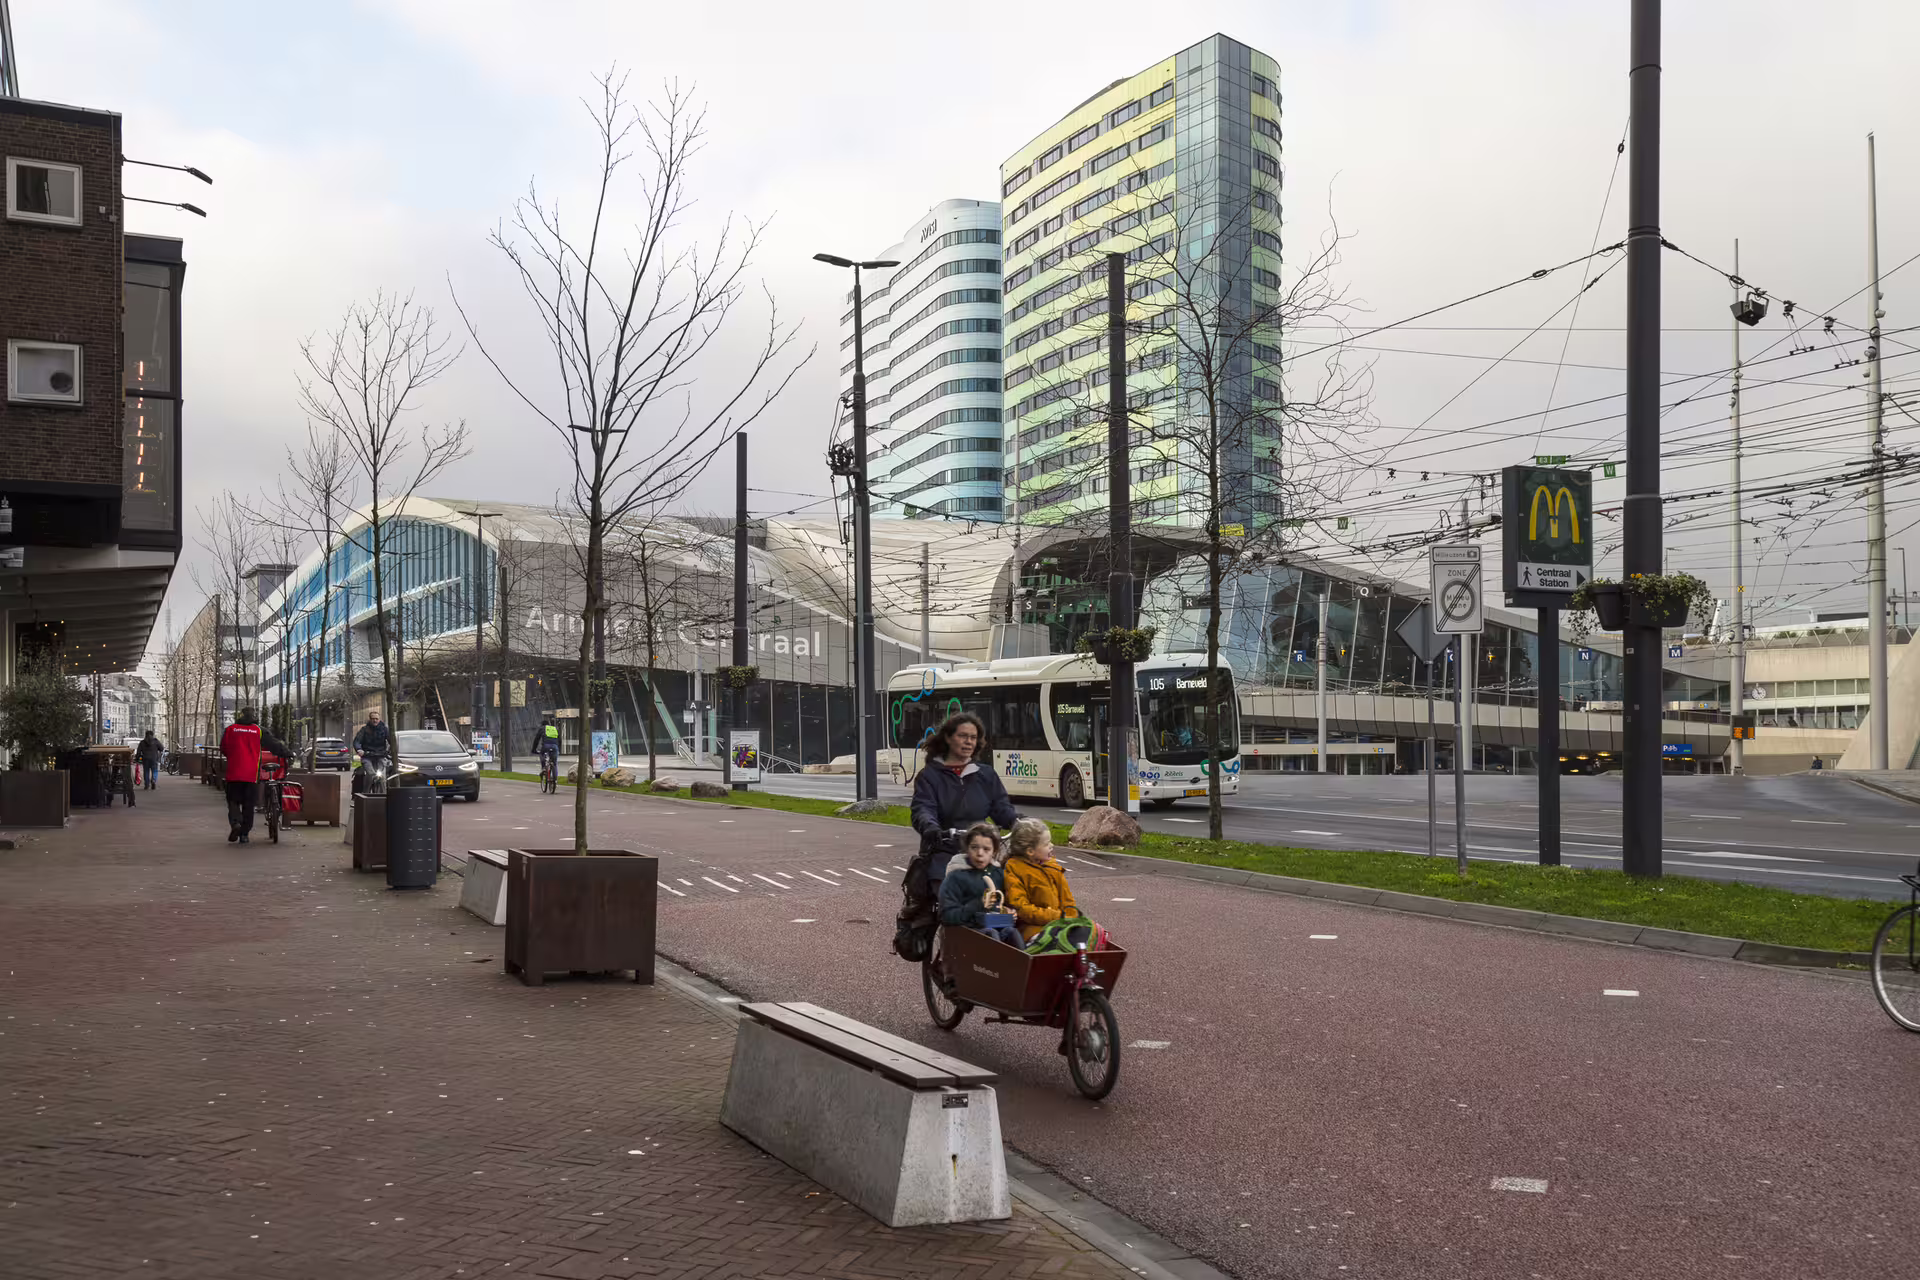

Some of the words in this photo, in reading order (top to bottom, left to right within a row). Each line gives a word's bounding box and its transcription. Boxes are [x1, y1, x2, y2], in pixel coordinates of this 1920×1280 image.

[1605, 466, 1614, 475] W
[1447, 569, 1467, 577] ZONE
[1536, 567, 1571, 578] Centraal
[1539, 578, 1569, 588] Station
[1360, 587, 1368, 597] Q
[1025, 601, 1032, 610] S
[1581, 652, 1589, 661] N
[1671, 649, 1681, 657] M
[1297, 654, 1303, 662] R
[1150, 678, 1165, 690] 105
[1176, 677, 1207, 689] Barneveld
[1005, 759, 1038, 777] RRReis
